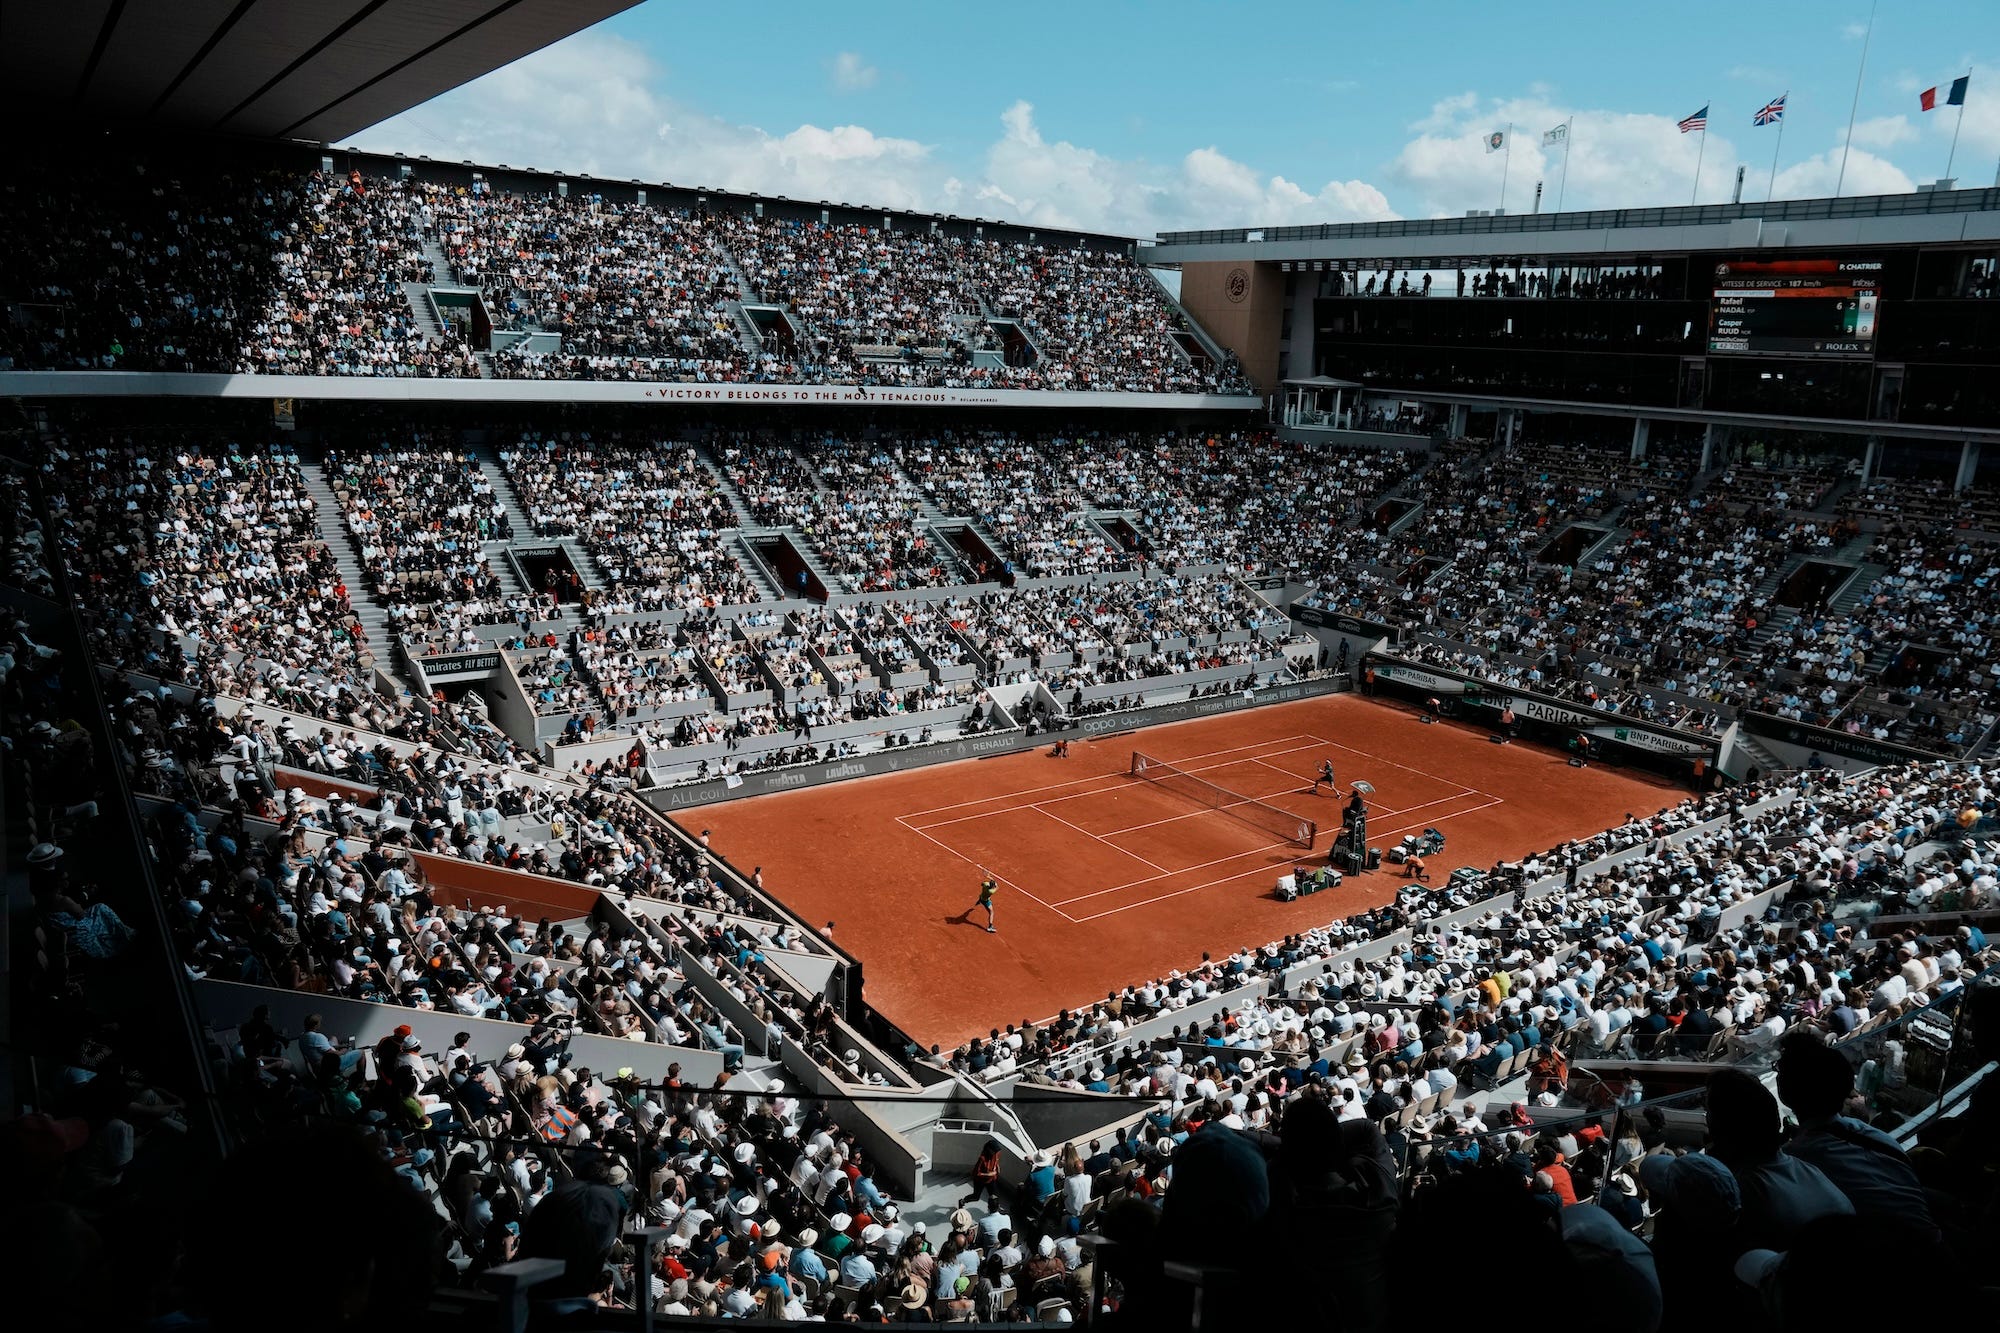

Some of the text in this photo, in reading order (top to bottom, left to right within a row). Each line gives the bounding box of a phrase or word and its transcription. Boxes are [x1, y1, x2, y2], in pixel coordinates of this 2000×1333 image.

[1846, 263, 1882, 271] CHATRIER
[1757, 280, 1783, 288] SERVICE
[1802, 279, 1822, 288] km/h
[1720, 297, 1744, 305] Rafael
[1719, 306, 1746, 314] NADAL
[1718, 318, 1744, 328] Casper
[1717, 327, 1740, 335] RUUD
[1824, 343, 1859, 351] ROLEX
[659, 388, 722, 400] VICTORY
[728, 390, 788, 400] BELONGS
[793, 391, 809, 401] TO
[815, 391, 838, 401] THE
[844, 392, 877, 402] MOST
[881, 392, 946, 403] TENACIOUS
[464, 659, 477, 669] FLY
[1407, 671, 1437, 686] PARIBAS
[1194, 700, 1223, 714] Emirates
[1526, 701, 1590, 728] PARIBAS
[1084, 717, 1116, 735] oppo
[972, 737, 1016, 753] RENAULT
[1630, 730, 1649, 742] BNP
[1650, 736, 1690, 753] PARIBAS
[825, 762, 867, 780] LAVAZZA
